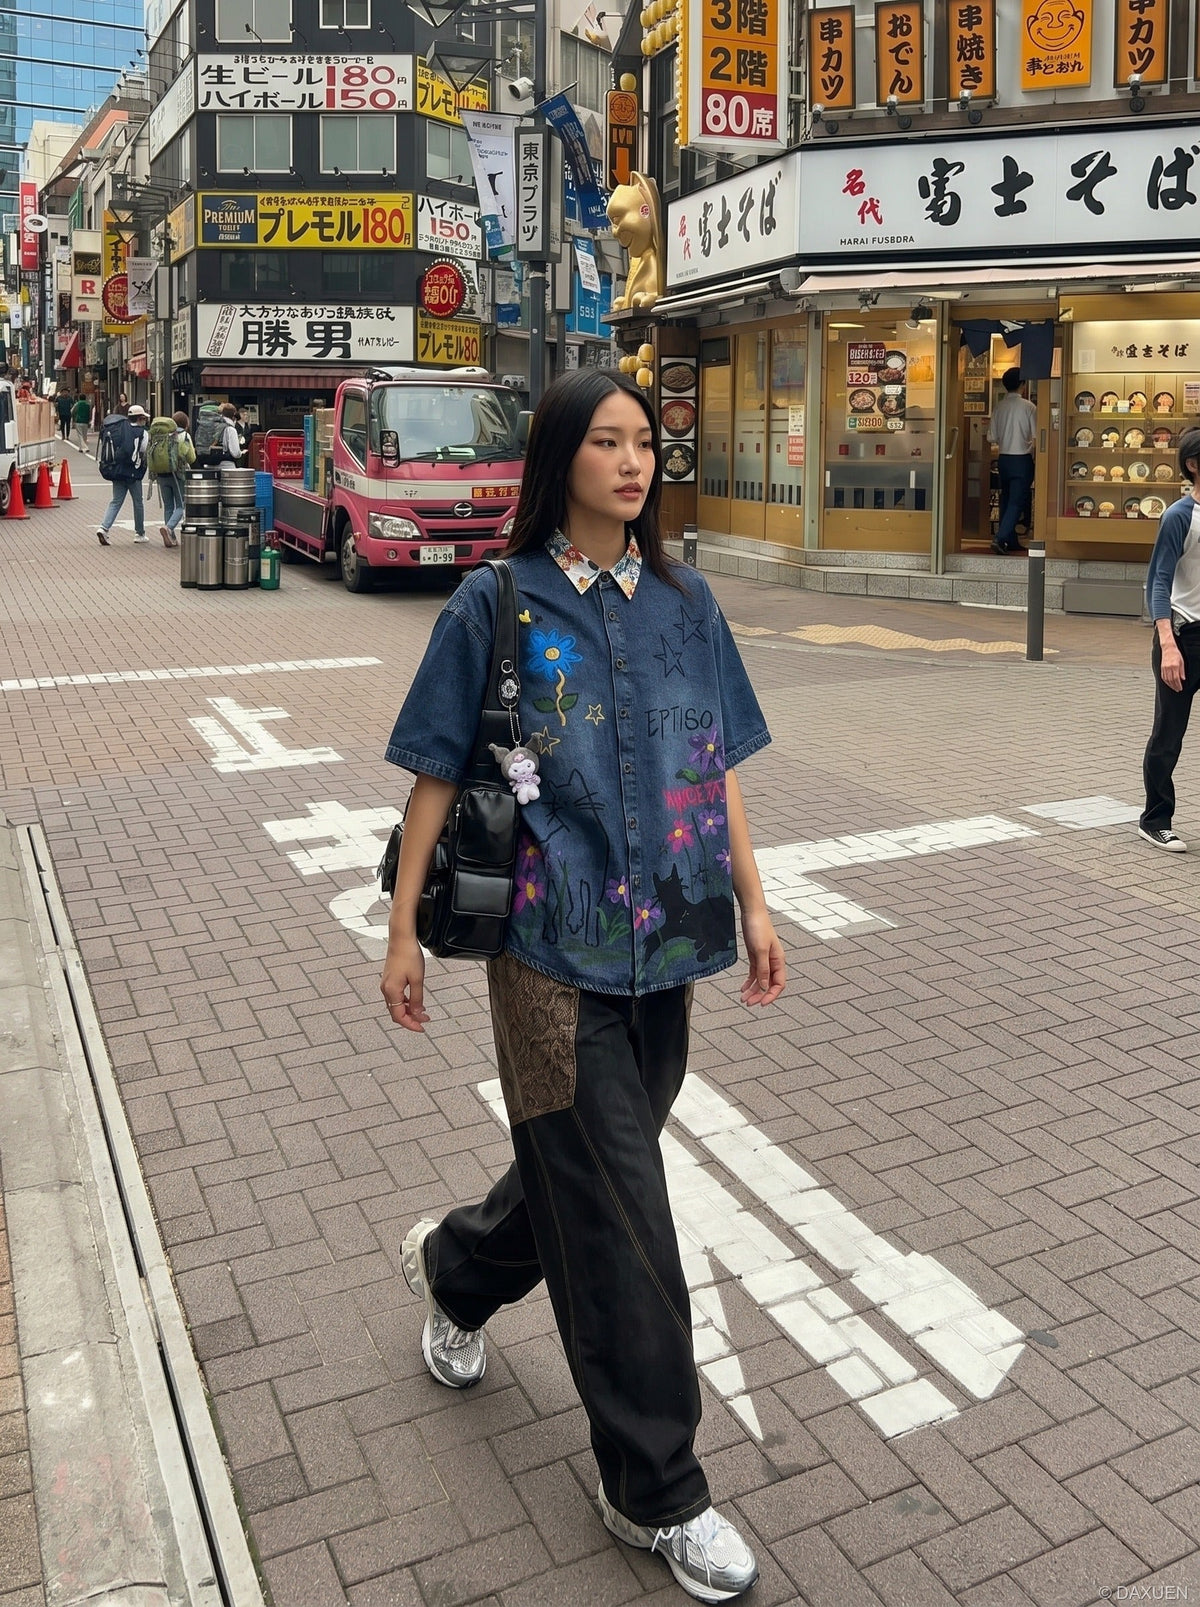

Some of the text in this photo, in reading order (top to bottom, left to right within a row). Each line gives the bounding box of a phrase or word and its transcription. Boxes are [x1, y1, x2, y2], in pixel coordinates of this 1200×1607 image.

[710, 0, 768, 36] 3階
[709, 46, 768, 88] 2階
[819, 18, 844, 100] 串カツ
[887, 13, 914, 95] おでん
[956, 4, 985, 90] 串焼き
[705, 93, 774, 137] 80席
[204, 209, 255, 224] PREMIUM
[842, 168, 884, 226] 名代
[238, 319, 352, 359] 勝男
